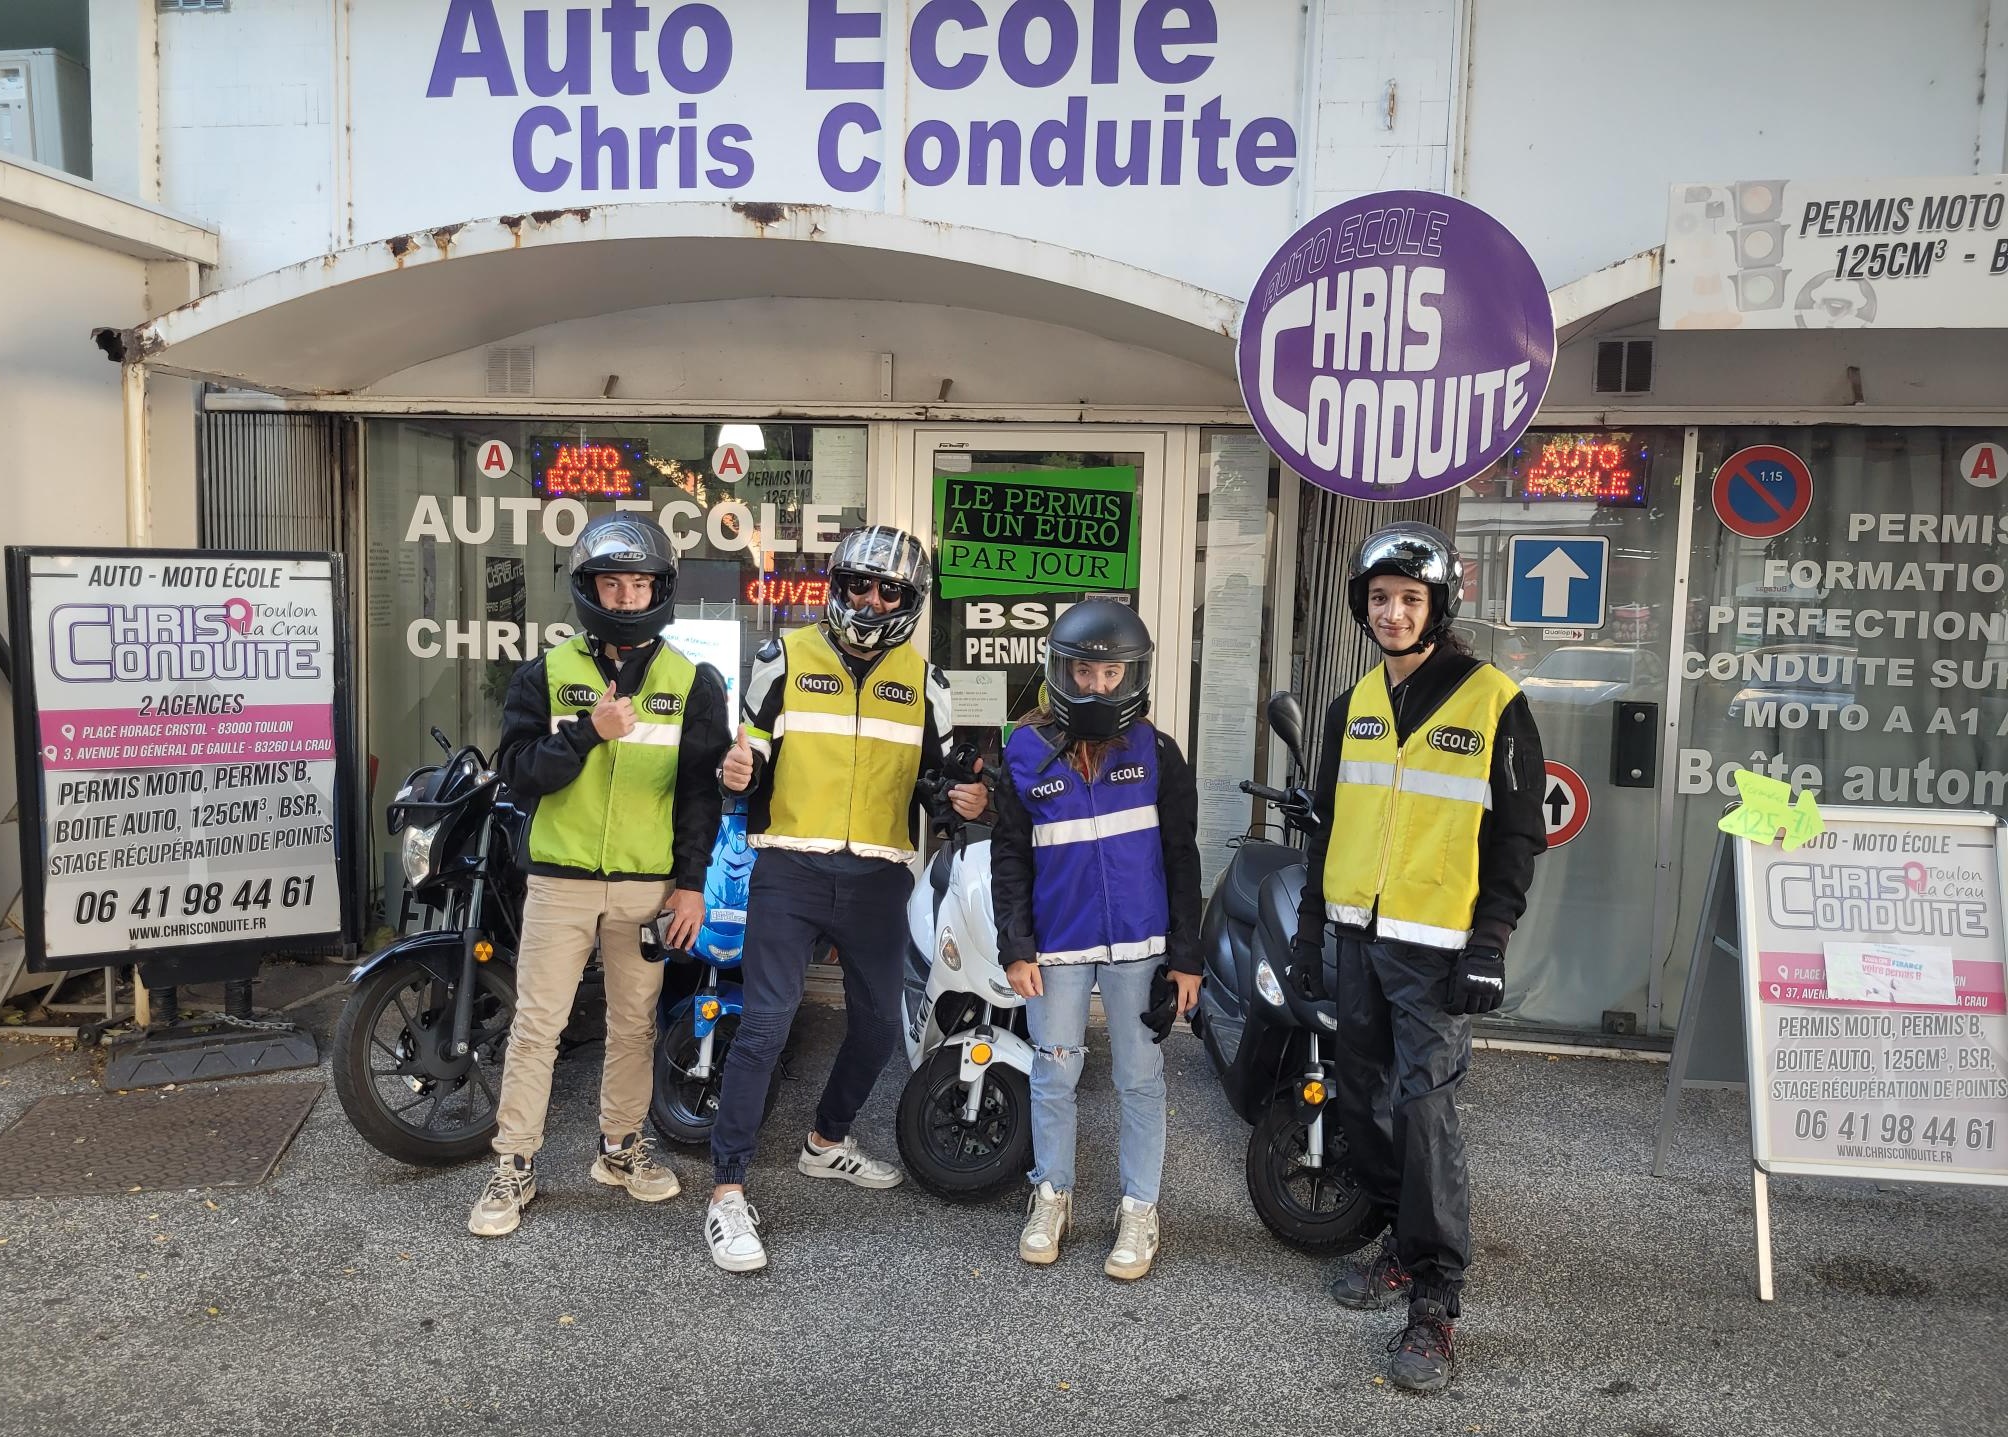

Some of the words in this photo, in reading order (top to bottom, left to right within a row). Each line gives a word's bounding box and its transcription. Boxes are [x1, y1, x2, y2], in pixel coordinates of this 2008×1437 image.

[426, 0, 733, 97] Auto
[806, 0, 1218, 91] Ecole
[511, 102, 755, 192] Chris
[818, 94, 1297, 193] Conduite
[1800, 197, 1913, 236] PERMIS
[1919, 193, 2005, 231] MOTO
[1262, 228, 1332, 312] AUTO
[1334, 208, 1449, 264] ECOLE
[1260, 265, 1445, 376] CHRIS
[1259, 358, 1530, 484] CONDUITE
[484, 445, 505, 471] A
[556, 447, 620, 468] AUTO
[718, 448, 742, 475] A
[1542, 443, 1621, 468] AUTO
[1970, 448, 1998, 479] A
[547, 468, 631, 491] ECOLE
[747, 470, 791, 487] PERMIS
[796, 469, 812, 485] MO
[1528, 469, 1631, 495] ECOLE
[1759, 471, 1783, 483] 1.15
[951, 484, 993, 509] LE
[1003, 488, 1121, 521] PERMIS
[405, 495, 588, 547] AUTO
[616, 500, 842, 553] COLE
[949, 511, 970, 535] A
[982, 512, 1024, 537] UN
[1034, 515, 1120, 547] EURO
[614, 552, 642, 560] HJC
[948, 544, 1017, 571] PAR
[1025, 551, 1110, 580] JOUR
[89, 565, 143, 587] AUTO
[162, 566, 218, 587] MOTO
[222, 563, 283, 588] ÉCOLE
[1764, 559, 2005, 593] FORMATIO
[251, 602, 317, 618] Toulon
[49, 603, 231, 649] CHRIS
[240, 620, 264, 637] La
[272, 621, 319, 637] Crau
[49, 639, 321, 683] CONDUITE
[1681, 652, 1915, 687] CONDUITE
[566, 690, 597, 702] CYCLO
[650, 699, 681, 711] ECOLE
[801, 677, 838, 691] MOTO
[878, 686, 913, 701] ECOLE
[139, 695, 153, 716] 2
[157, 694, 245, 716] AGENCES
[1744, 702, 1869, 731] MOTO
[1883, 706, 1912, 733] A
[1926, 707, 1979, 735] A1
[82, 725, 116, 739] PLACE
[119, 724, 162, 738] HORACE
[165, 723, 207, 737] CRISTOL
[217, 721, 252, 735] 83000
[254, 720, 293, 734] TOULON
[1350, 722, 1383, 736] MOTO
[1432, 731, 1477, 752] ECOLE
[76, 745, 121, 760] AVENUE
[123, 745, 138, 758] DU
[140, 742, 188, 757] GÉNÉRAL
[191, 743, 204, 755] DE
[206, 741, 246, 755] GAULLE
[254, 740, 288, 753] 83260
[290, 739, 303, 752] LA
[305, 738, 332, 751] CRAU
[58, 775, 140, 805] PERMIS
[144, 770, 208, 797] MOTO,
[214, 761, 290, 790] PERMIS
[293, 760, 311, 783] B,
[1032, 779, 1065, 798] CYCLO
[1110, 766, 1145, 781] ECOLE
[1842, 757, 2008, 805] autom
[55, 814, 118, 844] BOITE
[121, 808, 182, 836] AUTO,
[279, 793, 321, 818] BSR,
[50, 850, 108, 876] STAGE
[113, 834, 244, 869] RÉCUPÉRATION
[247, 831, 271, 853] DE
[274, 824, 333, 849] POINTS
[1801, 831, 1838, 849] UTO
[1853, 833, 1901, 853] MOTO
[1901, 831, 1952, 854] ÉCOLE
[1766, 861, 1909, 904] CHRIS
[1926, 866, 1983, 882] Toulon
[75, 889, 119, 925] 06
[130, 885, 171, 920] 41
[183, 881, 224, 916] 98
[232, 878, 272, 911] 44
[282, 874, 316, 908] 61
[1917, 882, 1937, 897] La
[1943, 883, 1984, 898] Crau
[129, 917, 267, 940] WWW.CHRISCONDUITE.FR
[1767, 896, 1989, 938] CONDUITE
[1794, 968, 1820, 980] PLACE
[1965, 995, 1988, 1007] CRAU
[1778, 1016, 1840, 1038] PERMIS
[1844, 1015, 1897, 1040] MOTO,
[1901, 1015, 1964, 1037] PERMIS
[1969, 1015, 1985, 1038] B,
[1776, 1049, 1823, 1071] BOITE
[1827, 1048, 1876, 1073] AUTO,
[1958, 1048, 1996, 1070] BSR,
[1772, 1080, 1818, 1099] STAGE
[1821, 1078, 1929, 1099] RÉCUPÉRATION
[1934, 1080, 1951, 1099] DE
[1955, 1079, 2008, 1099] POINTS
[1795, 1108, 1828, 1140] 06
[1838, 1111, 1870, 1142] 41
[1881, 1113, 1915, 1145] 98
[1922, 1116, 1957, 1147] 44
[1966, 1118, 1996, 1150] 61
[1837, 1145, 1954, 1163] WWW.CHRISCONDUITE.FR
